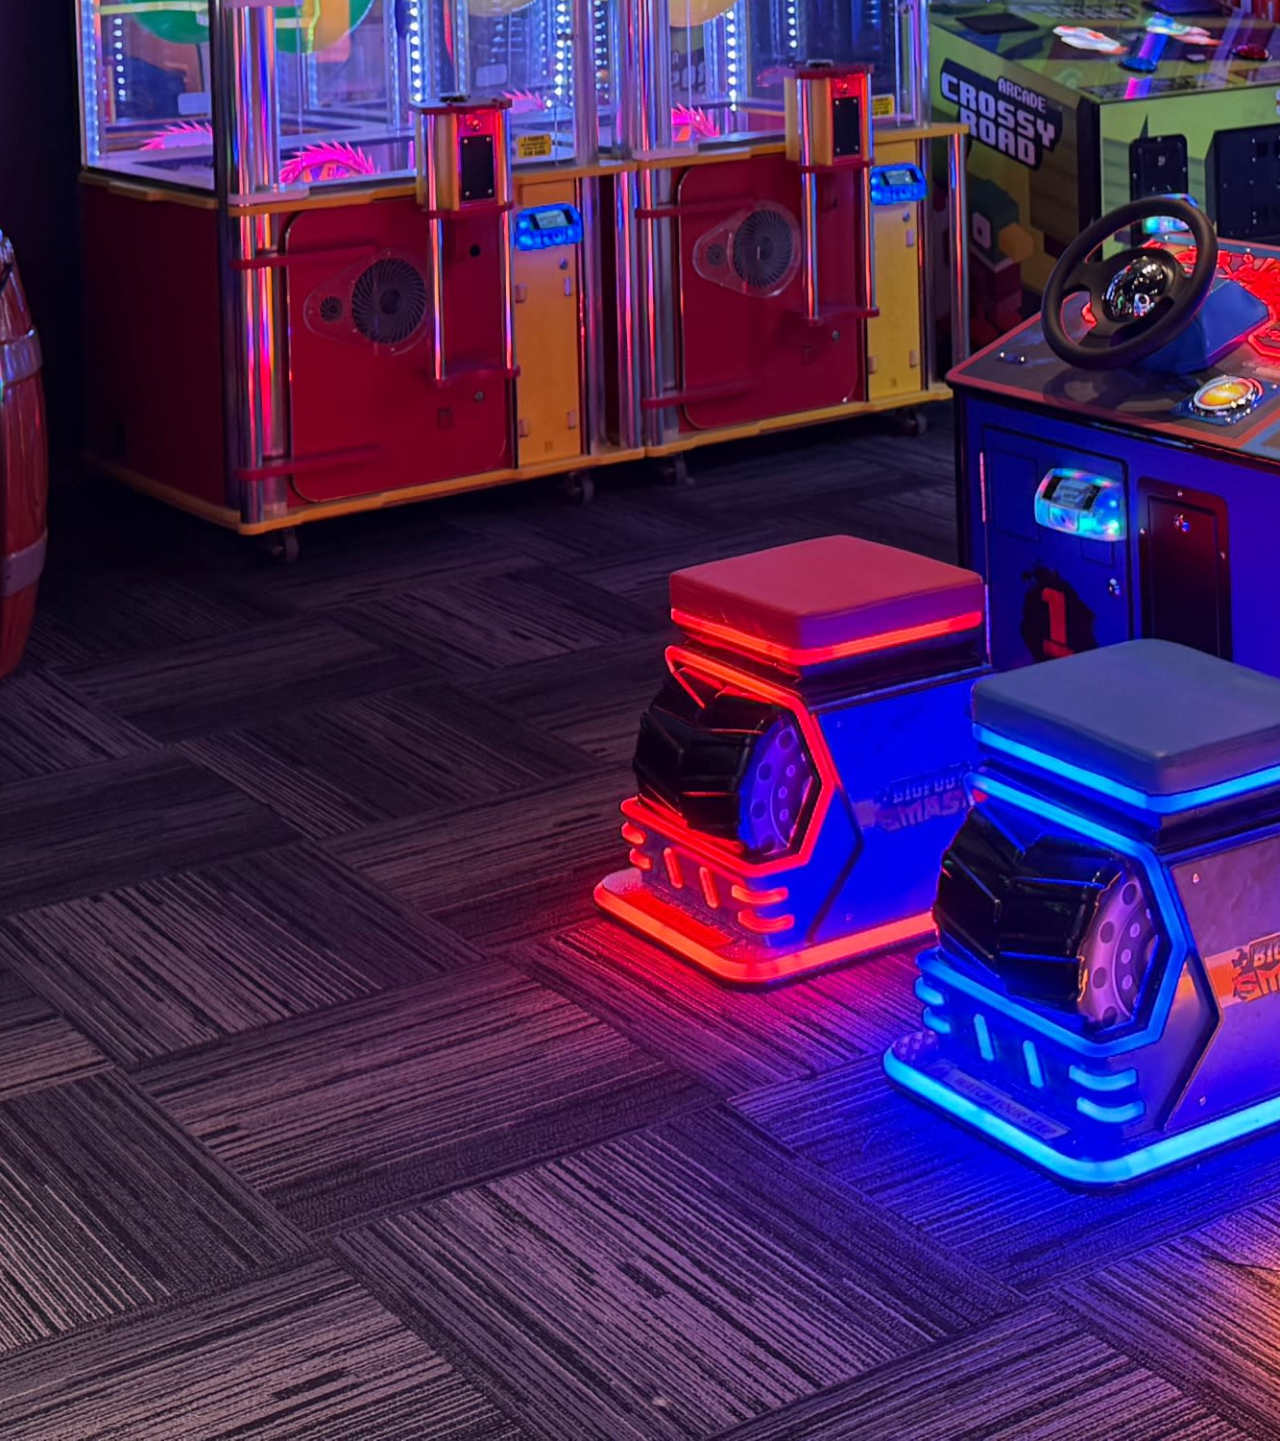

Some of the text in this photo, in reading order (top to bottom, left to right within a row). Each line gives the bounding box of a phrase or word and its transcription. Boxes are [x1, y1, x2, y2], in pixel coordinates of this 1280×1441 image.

[942, 72, 1055, 147] CROSSY
[998, 78, 1047, 113] ARCADE
[960, 106, 1037, 167] ROAD
